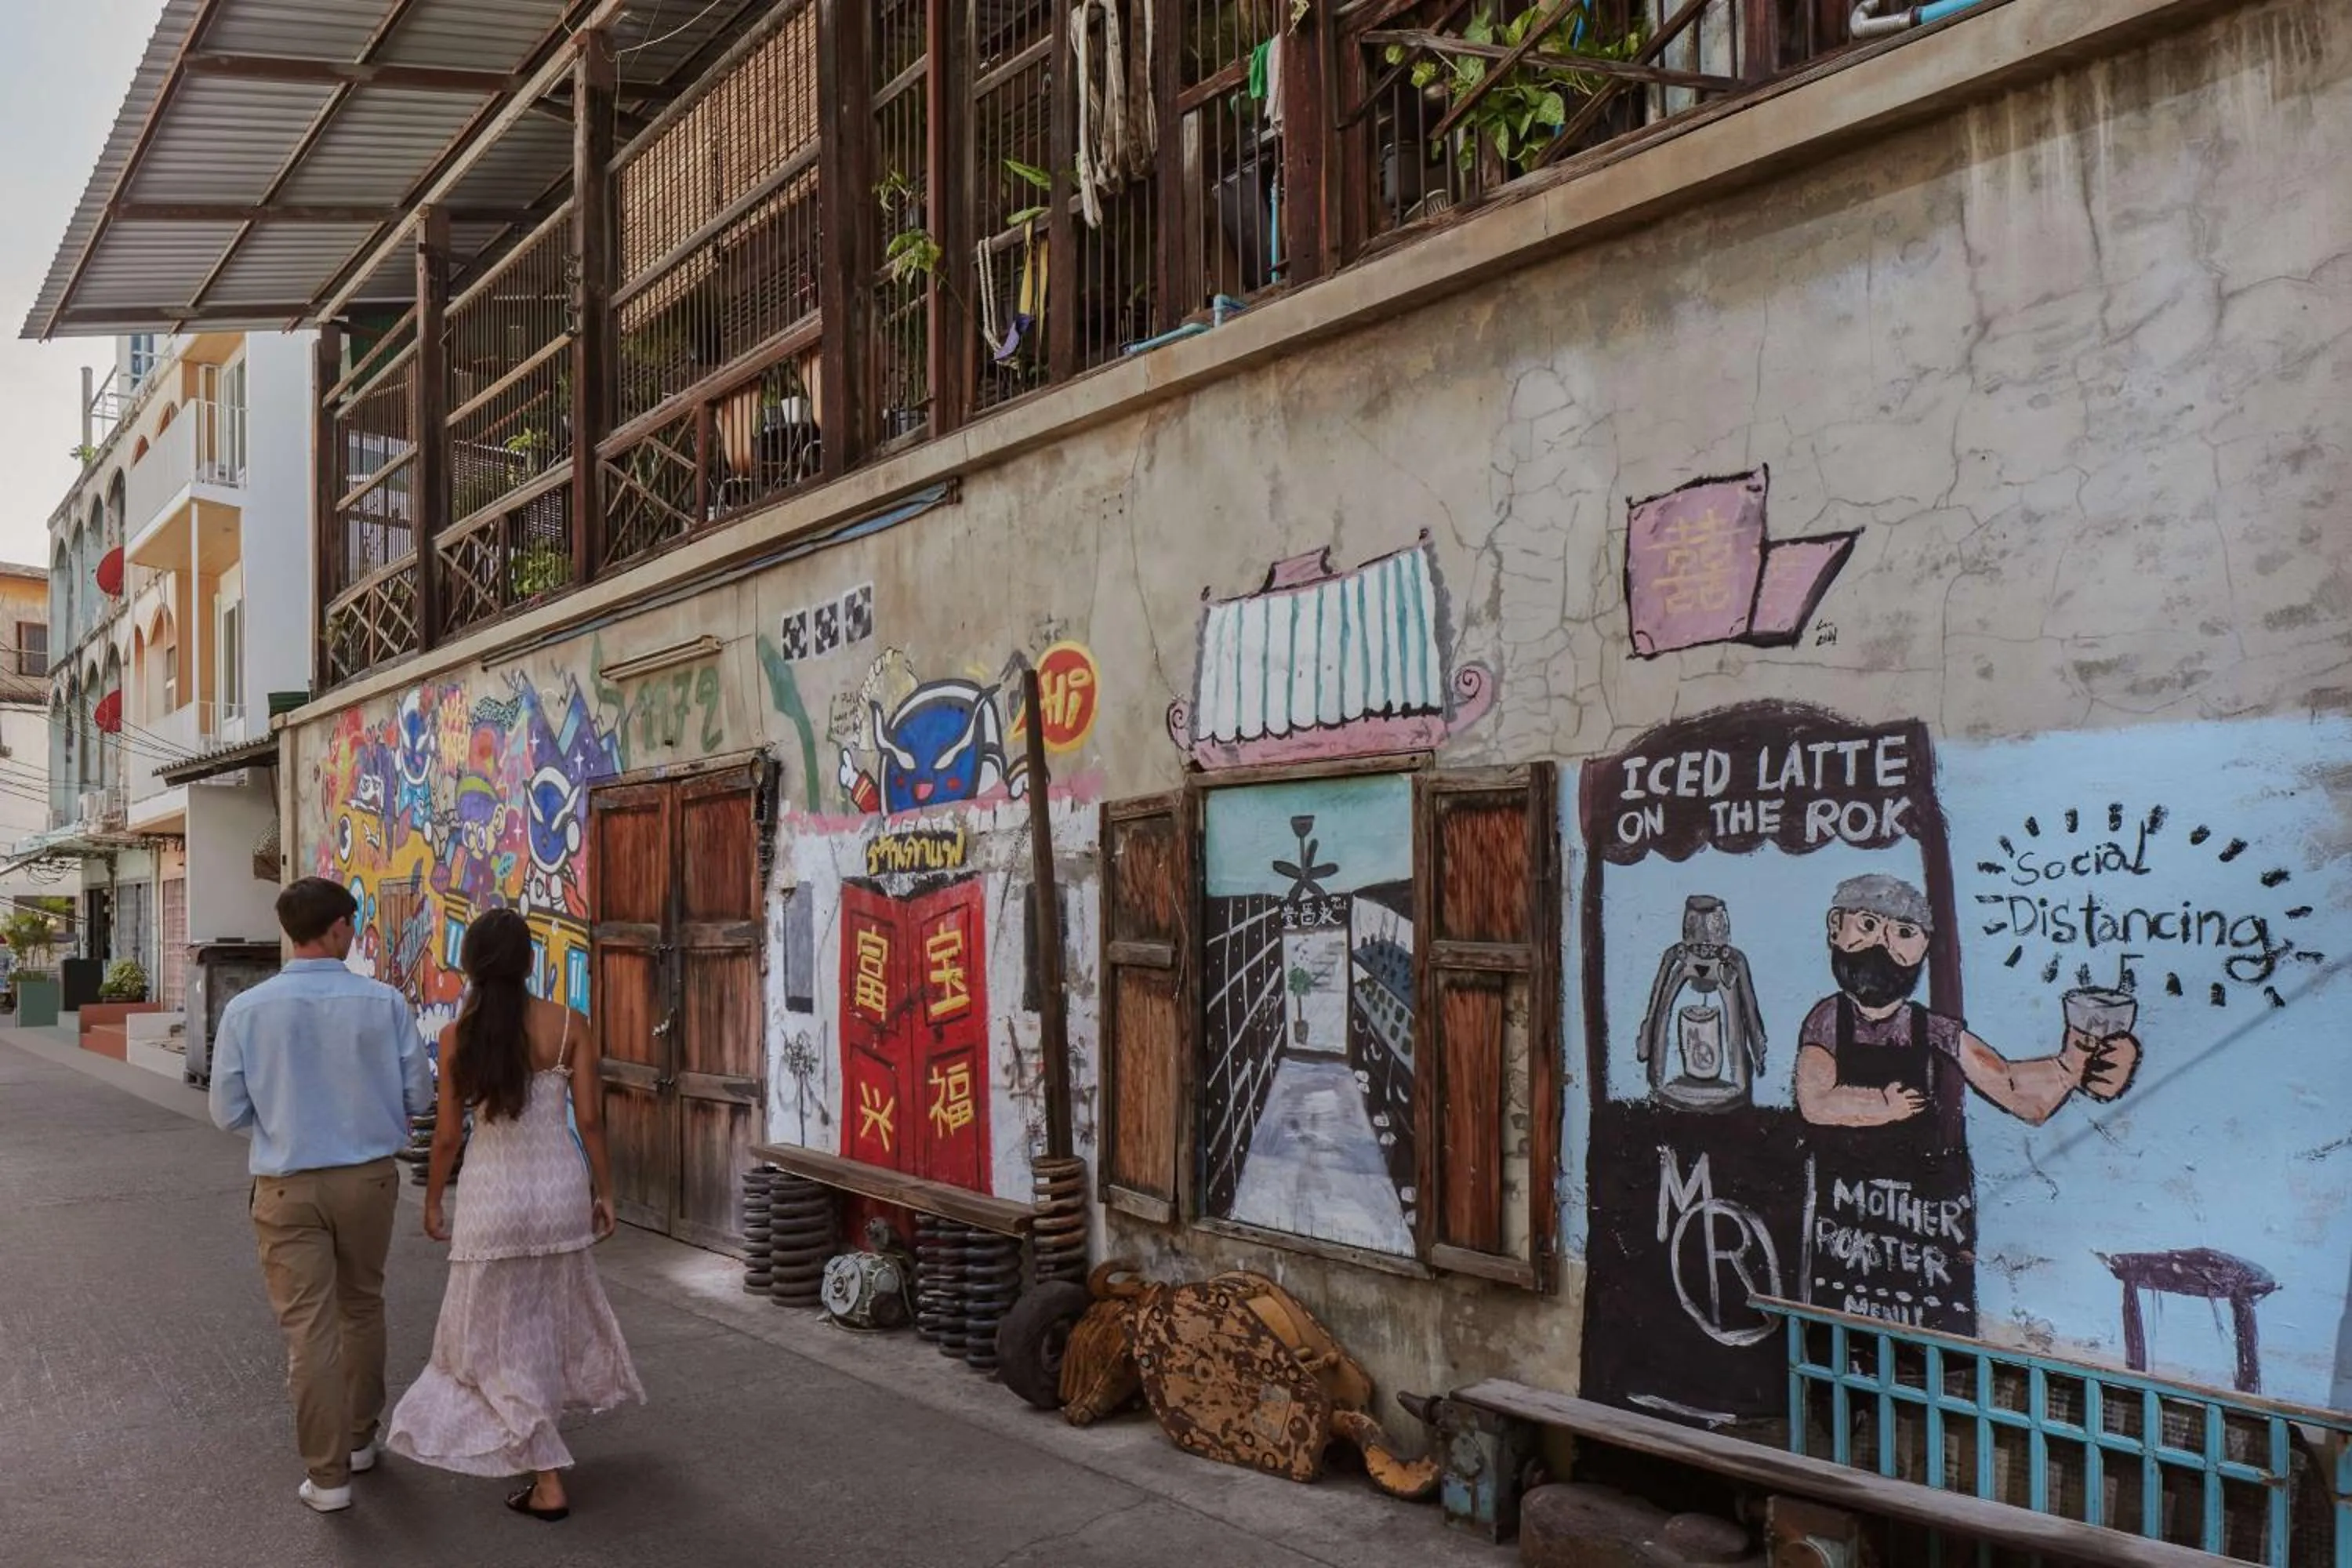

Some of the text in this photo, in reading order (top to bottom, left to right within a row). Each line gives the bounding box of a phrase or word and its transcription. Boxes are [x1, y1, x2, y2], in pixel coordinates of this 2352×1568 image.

[1040, 668, 1091, 729] Hi
[1621, 735, 1909, 800] ICED LATTE
[1617, 798, 1911, 844] ON THE ROK
[2011, 820, 2151, 886] Social
[2009, 891, 2294, 984] Distancing
[1815, 1216, 1952, 1287] ROASTER
